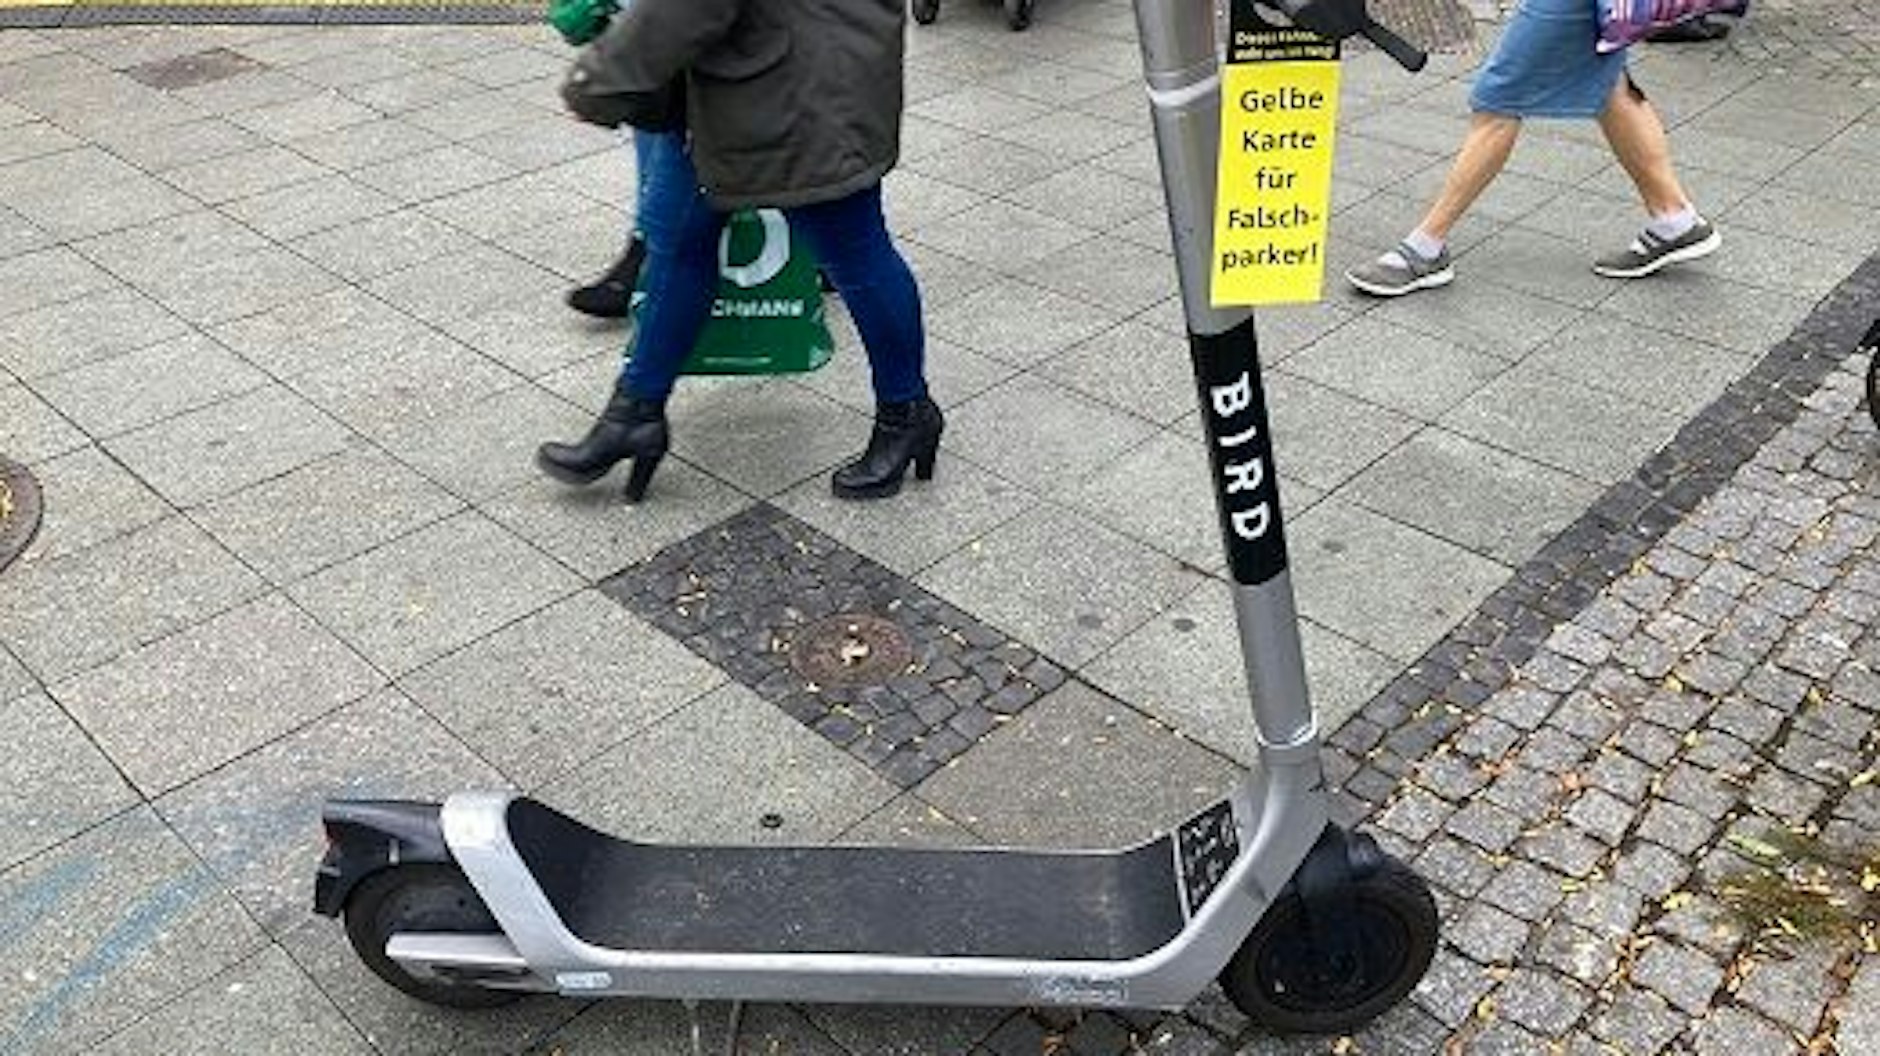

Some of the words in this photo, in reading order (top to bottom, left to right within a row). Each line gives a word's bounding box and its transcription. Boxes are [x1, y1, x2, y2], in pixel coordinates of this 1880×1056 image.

[1240, 87, 1323, 112] Gelbe
[1242, 130, 1316, 152] Karte
[1255, 165, 1297, 190] für
[1228, 203, 1319, 229] Falsch-
[1221, 242, 1318, 273] parker!
[1210, 371, 1270, 540] BIRD
